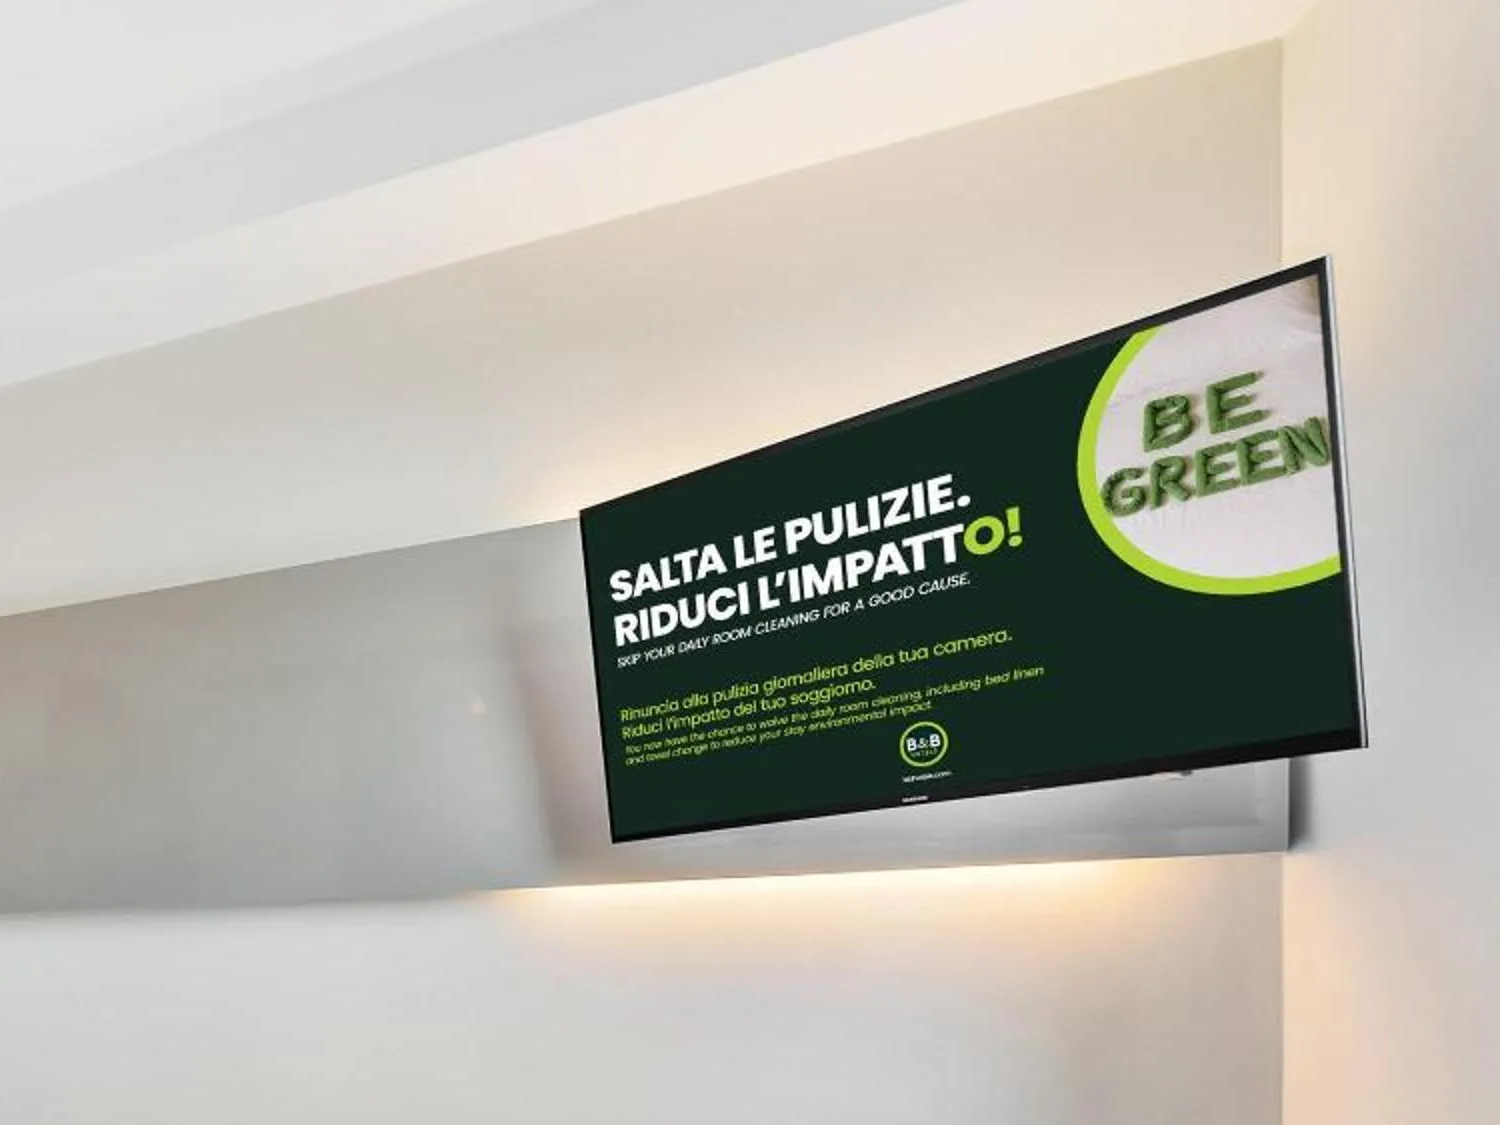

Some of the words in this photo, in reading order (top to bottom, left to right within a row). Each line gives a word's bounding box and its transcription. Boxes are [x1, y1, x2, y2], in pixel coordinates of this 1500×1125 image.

[1142, 370, 1264, 452] BE
[1100, 415, 1331, 518] GREEN
[609, 541, 728, 602] SALTA
[733, 526, 777, 570] LE
[784, 473, 972, 555] PULIZIE.
[613, 581, 751, 647] RIDUCI
[757, 505, 1025, 612] L'IMPATTO!
[616, 652, 642, 669] SKIP
[644, 643, 675, 662] YOUR
[677, 634, 710, 654] DAILY
[711, 627, 752, 645] ROOM
[754, 609, 821, 636] CLEANING
[823, 601, 851, 619] FOR
[853, 597, 865, 611] A
[867, 585, 915, 608] GOOD
[917, 571, 971, 596] CAUSE.
[619, 698, 679, 722] Rinuncia
[682, 692, 709, 709] alla
[712, 681, 760, 707] pulizia
[851, 652, 895, 673] della
[898, 647, 929, 663] tua
[932, 630, 1013, 656] camera.
[621, 717, 663, 740] Riduci
[760, 696, 788, 711] tuo
[789, 679, 877, 706] soggiorno.
[905, 732, 941, 752] B&B
